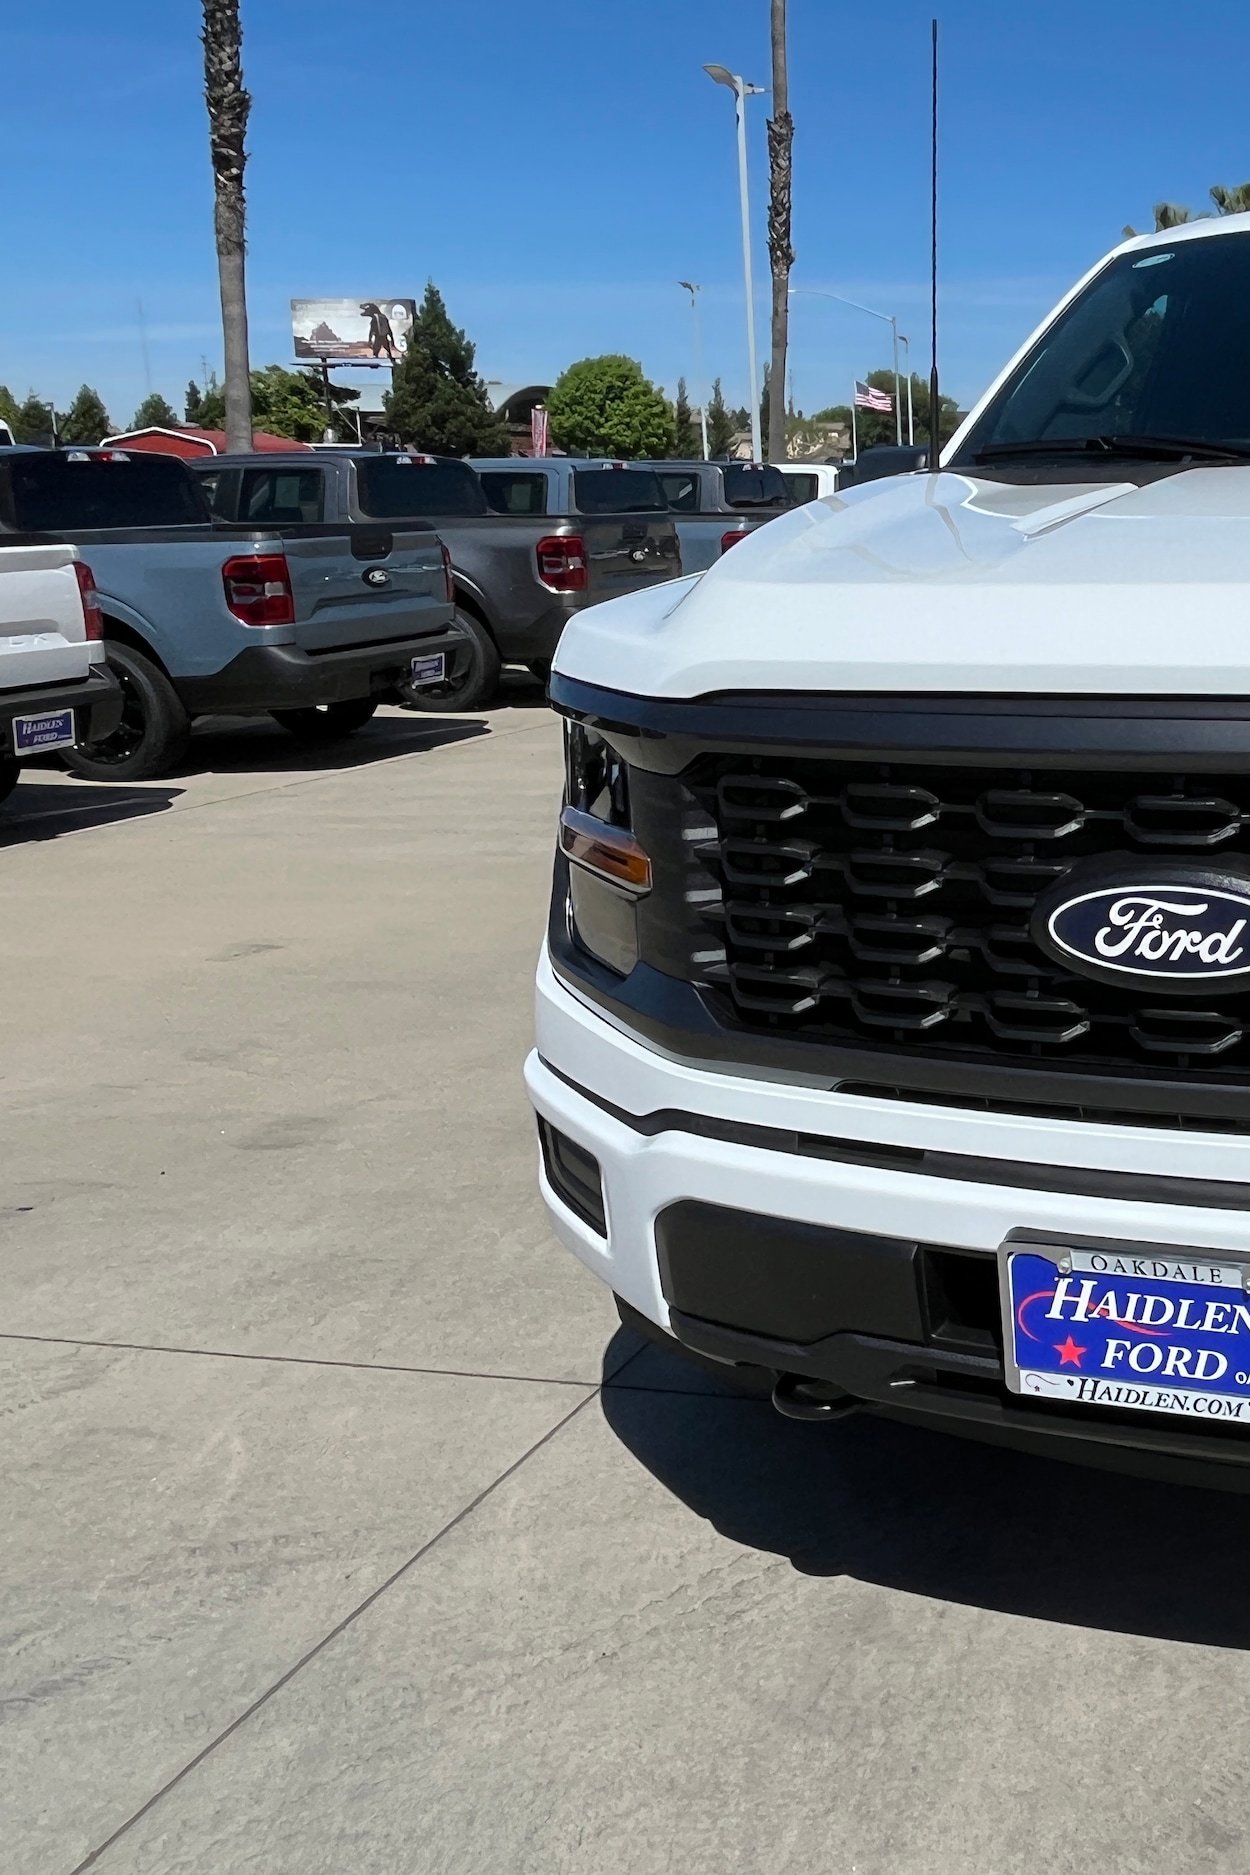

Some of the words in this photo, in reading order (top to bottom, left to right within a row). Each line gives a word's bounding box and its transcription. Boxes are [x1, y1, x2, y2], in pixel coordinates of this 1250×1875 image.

[1095, 897, 1247, 964] Ford
[1091, 1255, 1223, 1283] OAKDALE
[1100, 1338, 1229, 1381] FORD
[1076, 1377, 1245, 1417] HAIDLEN.COM
